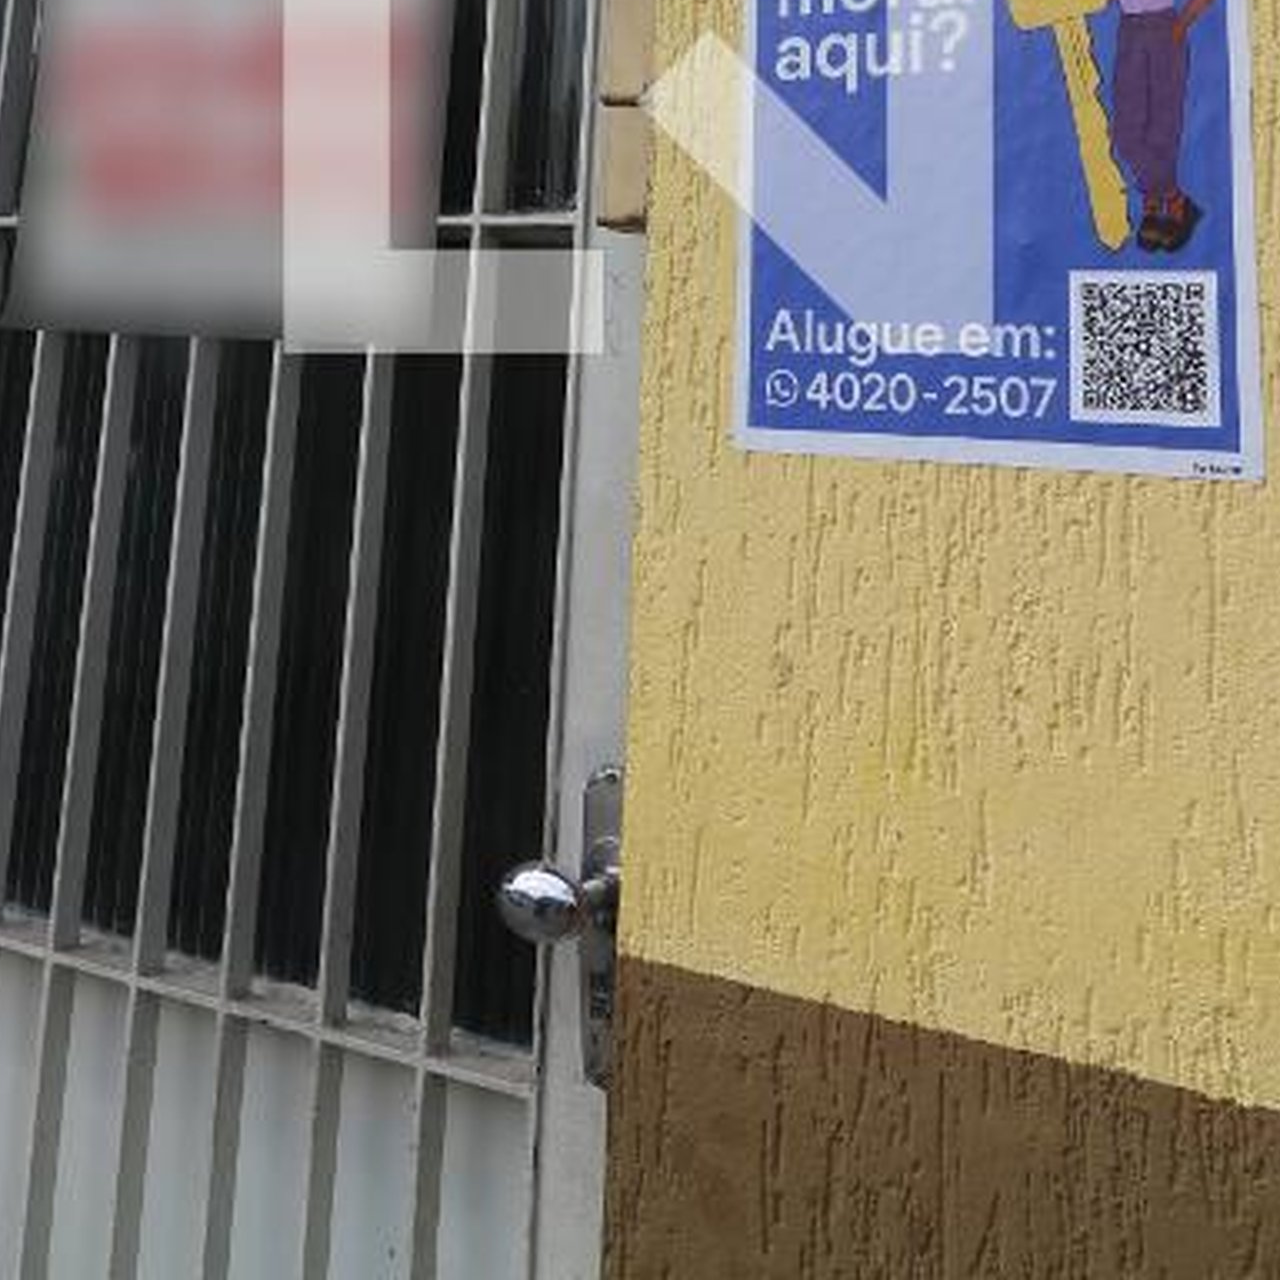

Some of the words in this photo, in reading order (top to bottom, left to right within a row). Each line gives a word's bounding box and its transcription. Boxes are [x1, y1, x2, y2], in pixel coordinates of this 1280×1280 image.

[776, 10, 967, 93] aqui?
[766, 308, 944, 366] Alugue
[958, 320, 1056, 359] em:
[807, 372, 1057, 418] 4020-2507
